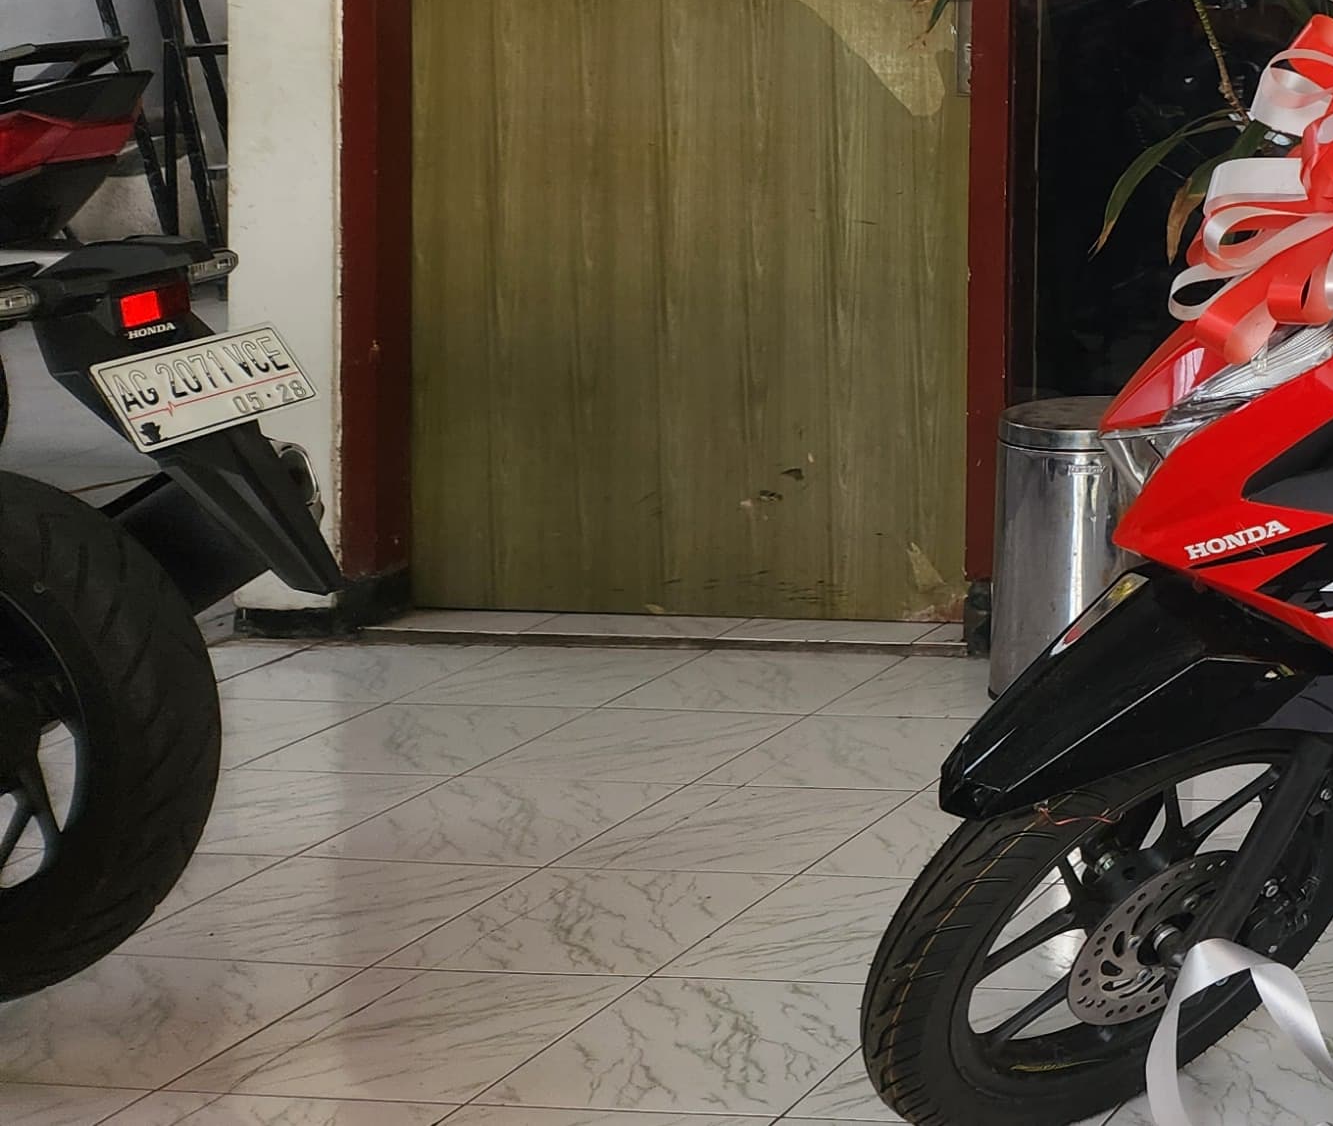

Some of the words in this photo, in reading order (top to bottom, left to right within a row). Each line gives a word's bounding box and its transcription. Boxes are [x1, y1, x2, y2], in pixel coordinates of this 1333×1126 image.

[127, 322, 176, 340] HONDA
[112, 369, 160, 413] AG
[155, 349, 233, 399] 2071
[222, 336, 290, 379] VCE
[1184, 520, 1291, 561] HONDA
